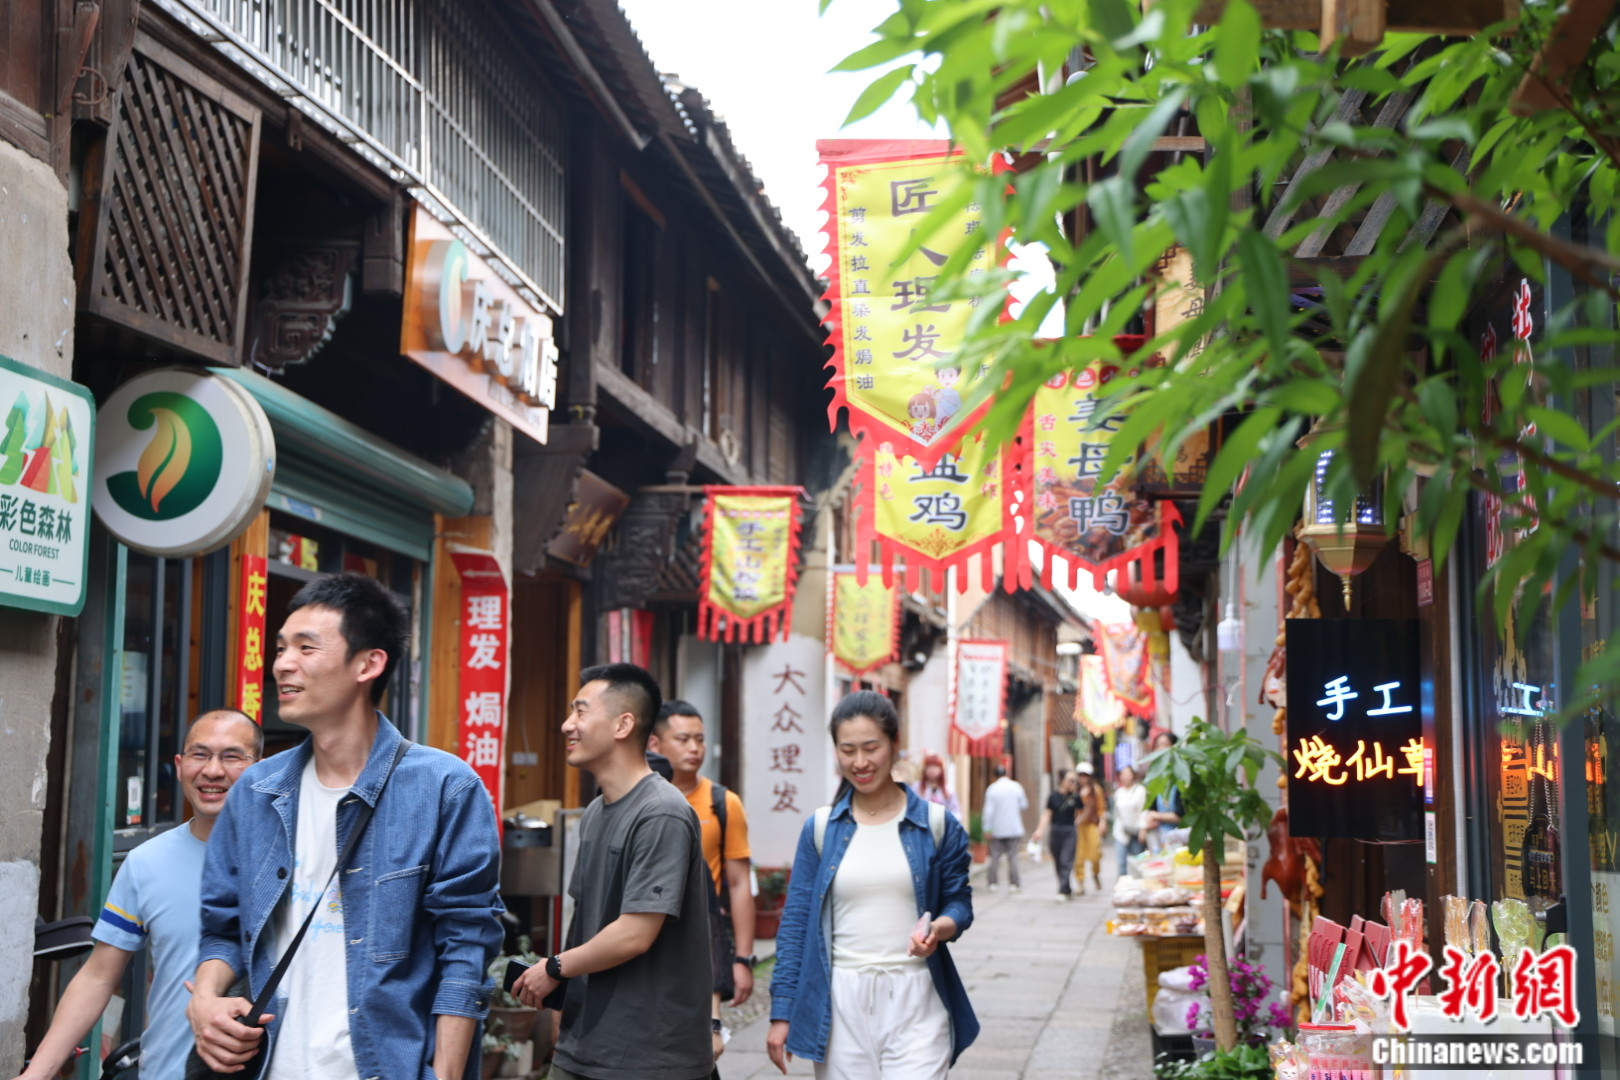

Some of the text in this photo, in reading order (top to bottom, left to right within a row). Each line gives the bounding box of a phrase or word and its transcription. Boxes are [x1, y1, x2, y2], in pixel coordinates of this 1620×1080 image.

[848, 206, 875, 390] 剪发拉直染发焗油
[1037, 413, 1058, 512] 舌尖美味
[0, 494, 72, 545] 彩色森林
[9, 538, 60, 560] COLOR FOREST
[15, 565, 51, 587] 儿童绘画
[465, 595, 503, 768] 理发 焗油
[1315, 674, 1413, 721] 手工
[769, 663, 807, 814] 大众理发
[1292, 733, 1425, 787] 烧仙草
